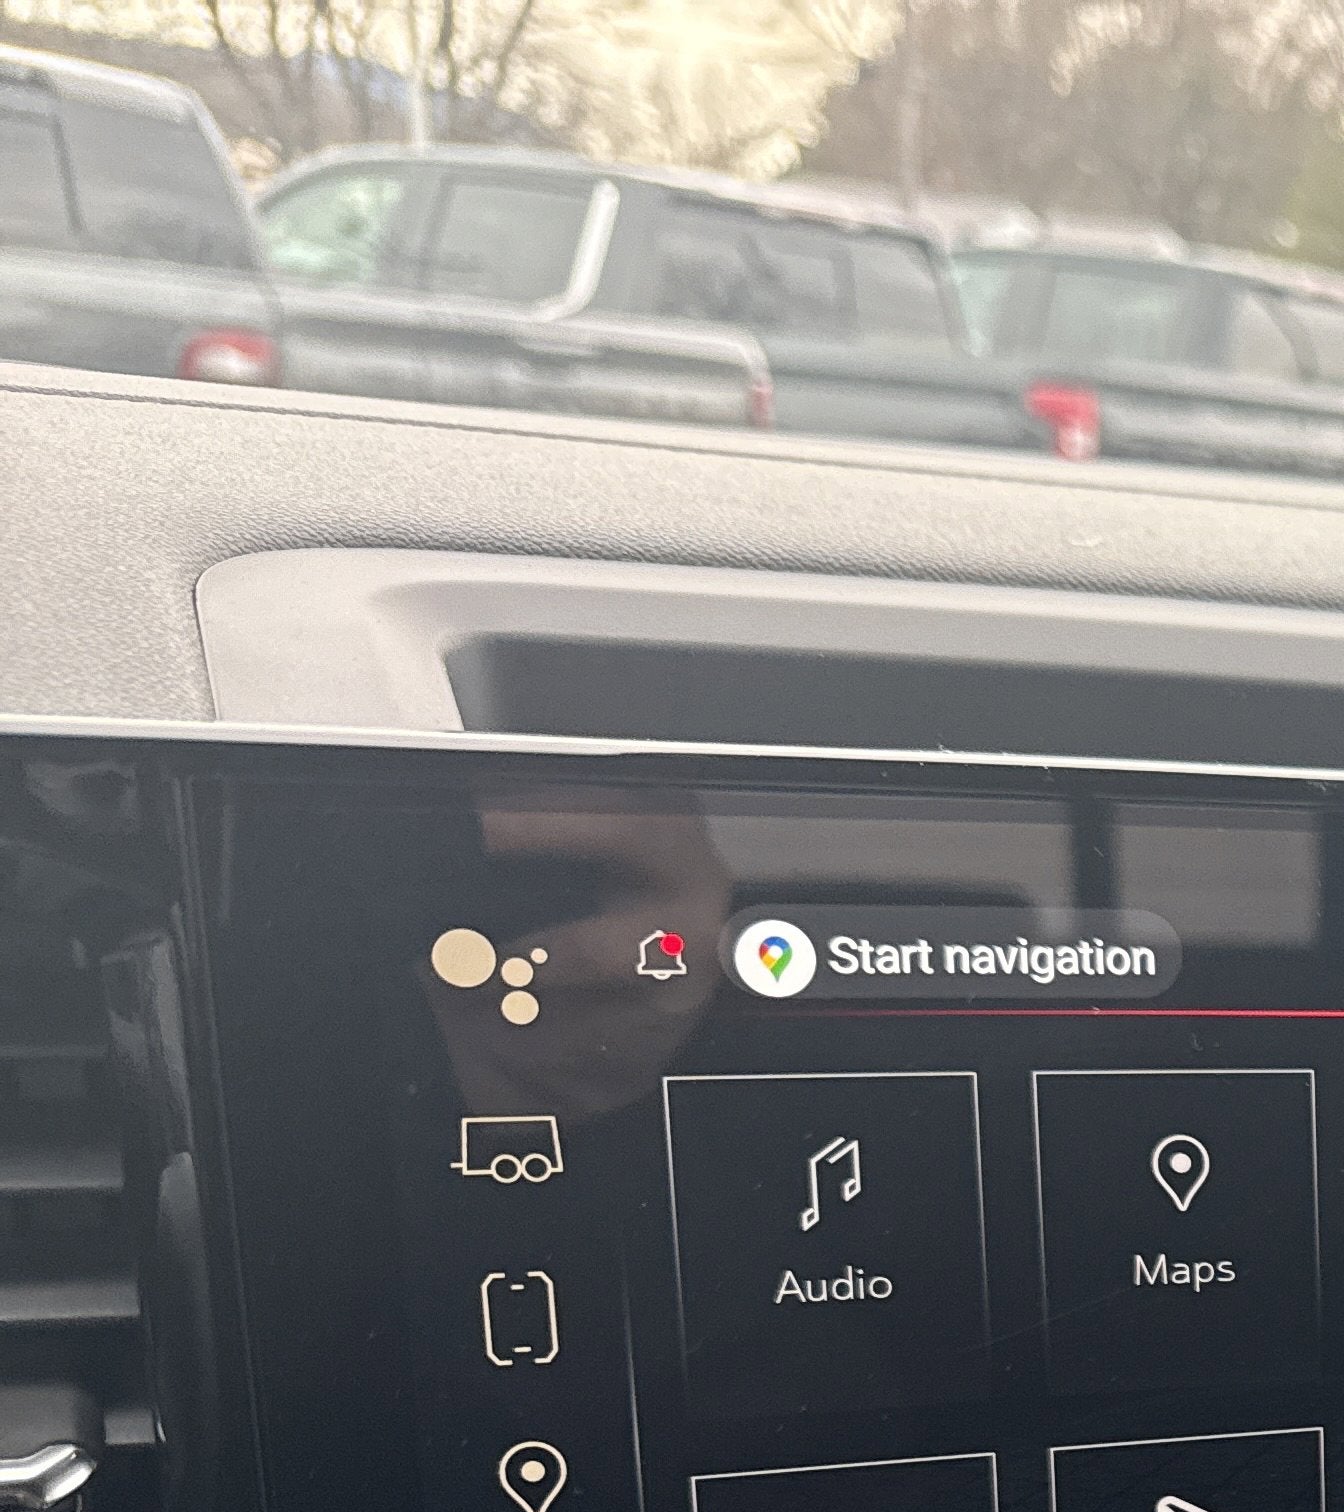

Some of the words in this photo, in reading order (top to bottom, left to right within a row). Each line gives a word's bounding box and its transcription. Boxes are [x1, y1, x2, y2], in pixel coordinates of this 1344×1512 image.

[827, 938, 934, 977] Start
[944, 938, 1158, 984] navigation
[775, 1267, 893, 1304] Audio
[1132, 1254, 1236, 1292] Maps
